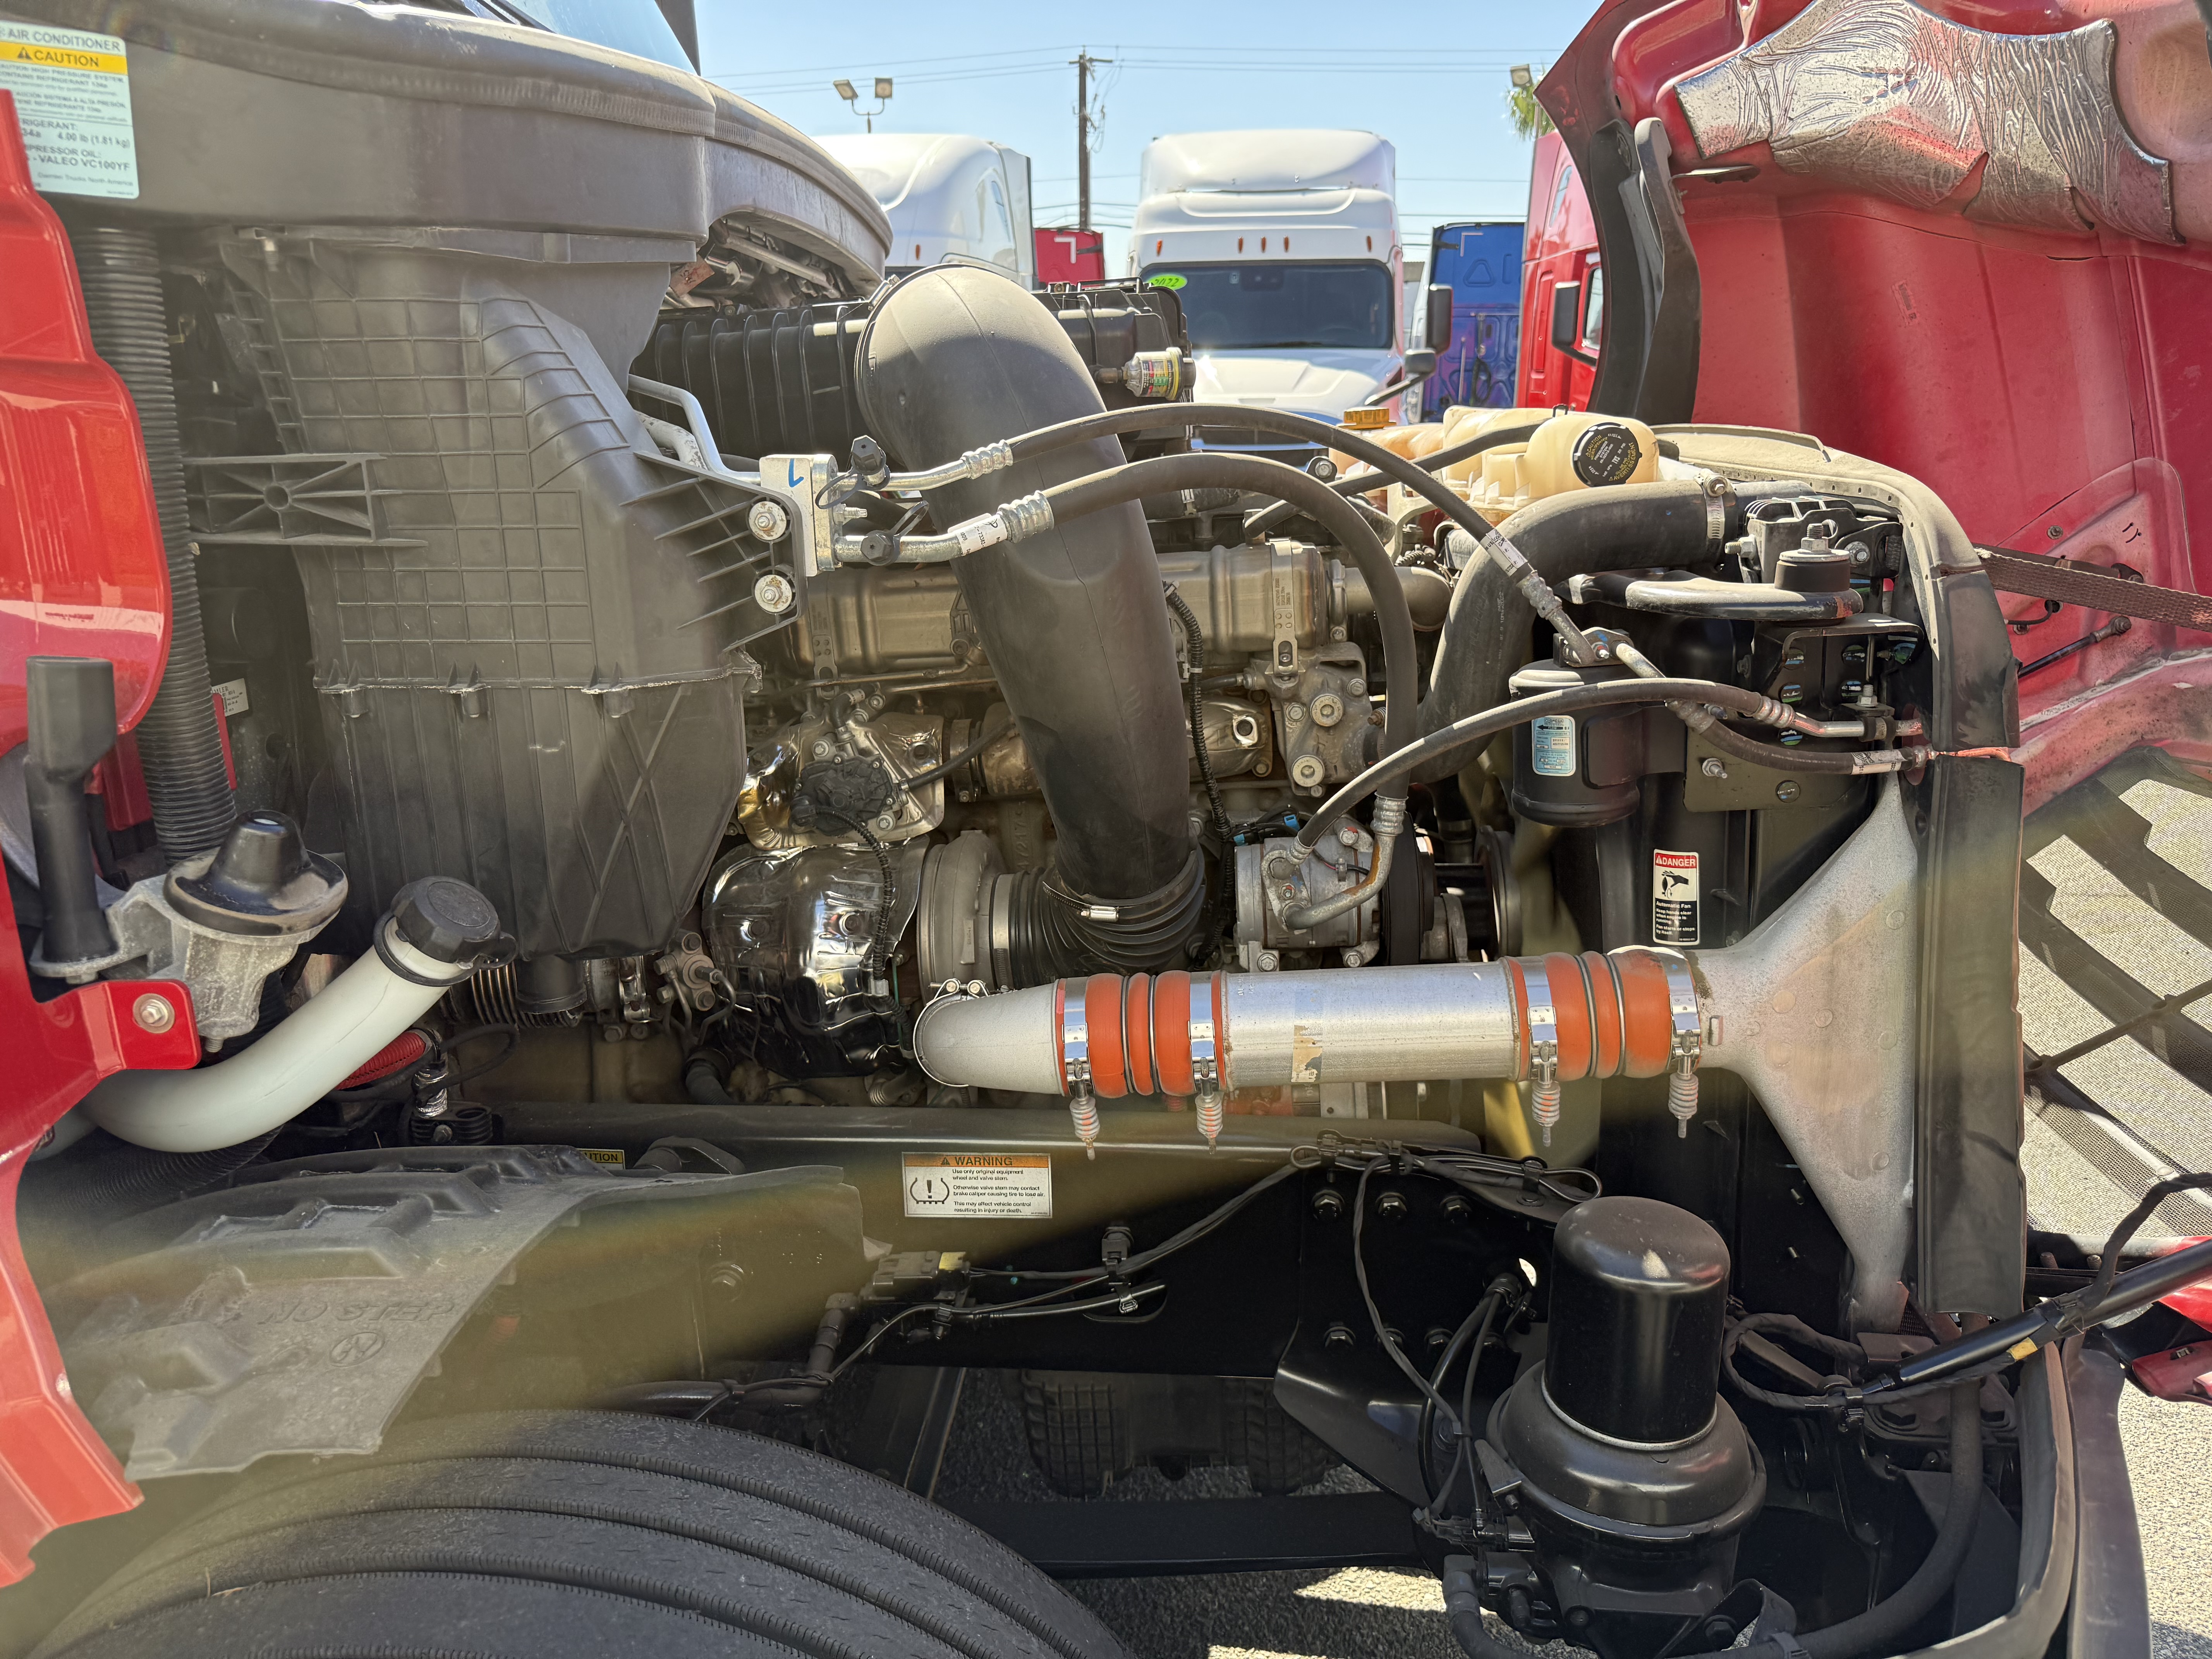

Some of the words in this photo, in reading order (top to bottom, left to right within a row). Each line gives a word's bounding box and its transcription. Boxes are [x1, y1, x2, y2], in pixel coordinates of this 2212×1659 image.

[8, 28, 29, 41] AIR
[33, 31, 120, 52] CONDITIONER
[34, 50, 99, 67] CAUTION
[0, 64, 29, 72] AUTION
[22, 118, 78, 131] RIGERANT:
[27, 144, 79, 156] PRESSOR
[38, 155, 78, 167] VALEO
[80, 158, 131, 171] VC100YF
[1611, 455, 1621, 464] TVS
[1662, 858, 1696, 867] DANGER
[955, 1156, 1012, 1166] WARNING
[257, 1301, 328, 1325] NO
[336, 1300, 455, 1321] STEP
